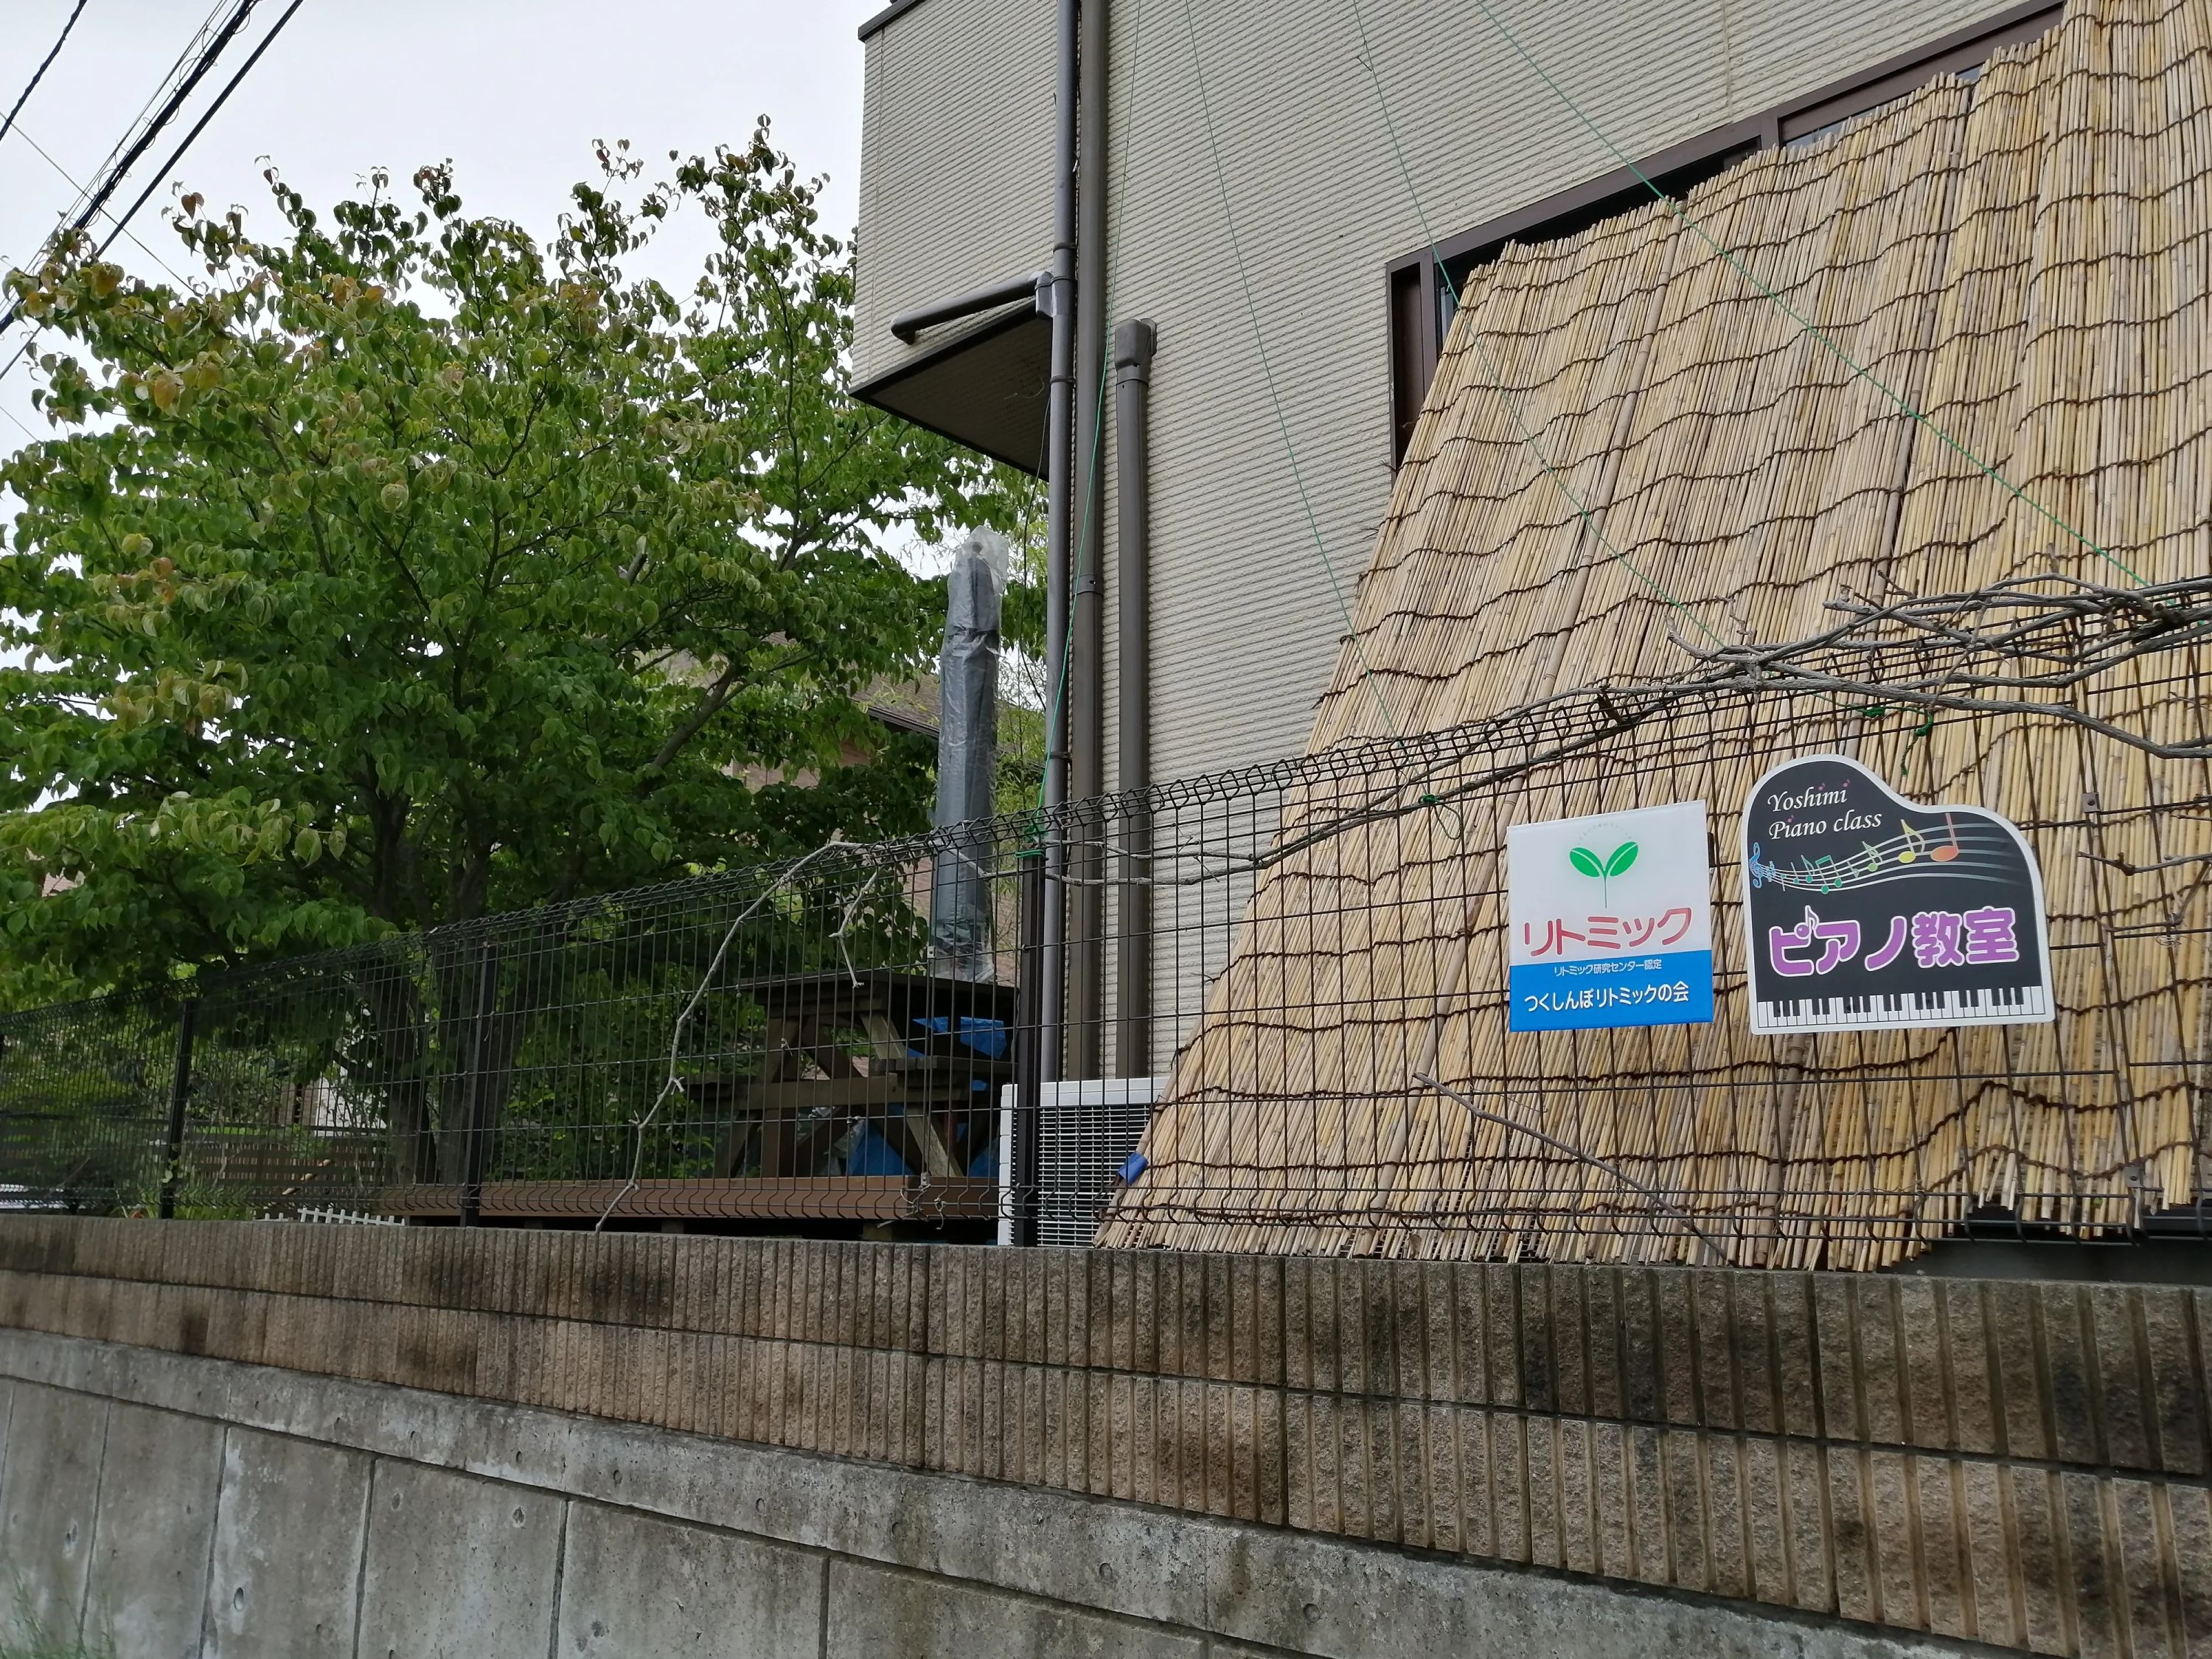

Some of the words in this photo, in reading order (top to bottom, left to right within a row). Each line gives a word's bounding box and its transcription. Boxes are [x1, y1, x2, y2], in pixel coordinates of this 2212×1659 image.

[1768, 782, 1848, 813] Yoshimi
[1770, 815, 1827, 840] Piano
[1834, 810, 1882, 832] class
[1524, 908, 1691, 956] リトミック
[1770, 906, 2020, 977] ピアノ教室
[1554, 959, 1662, 977] リトミック研究センター認定
